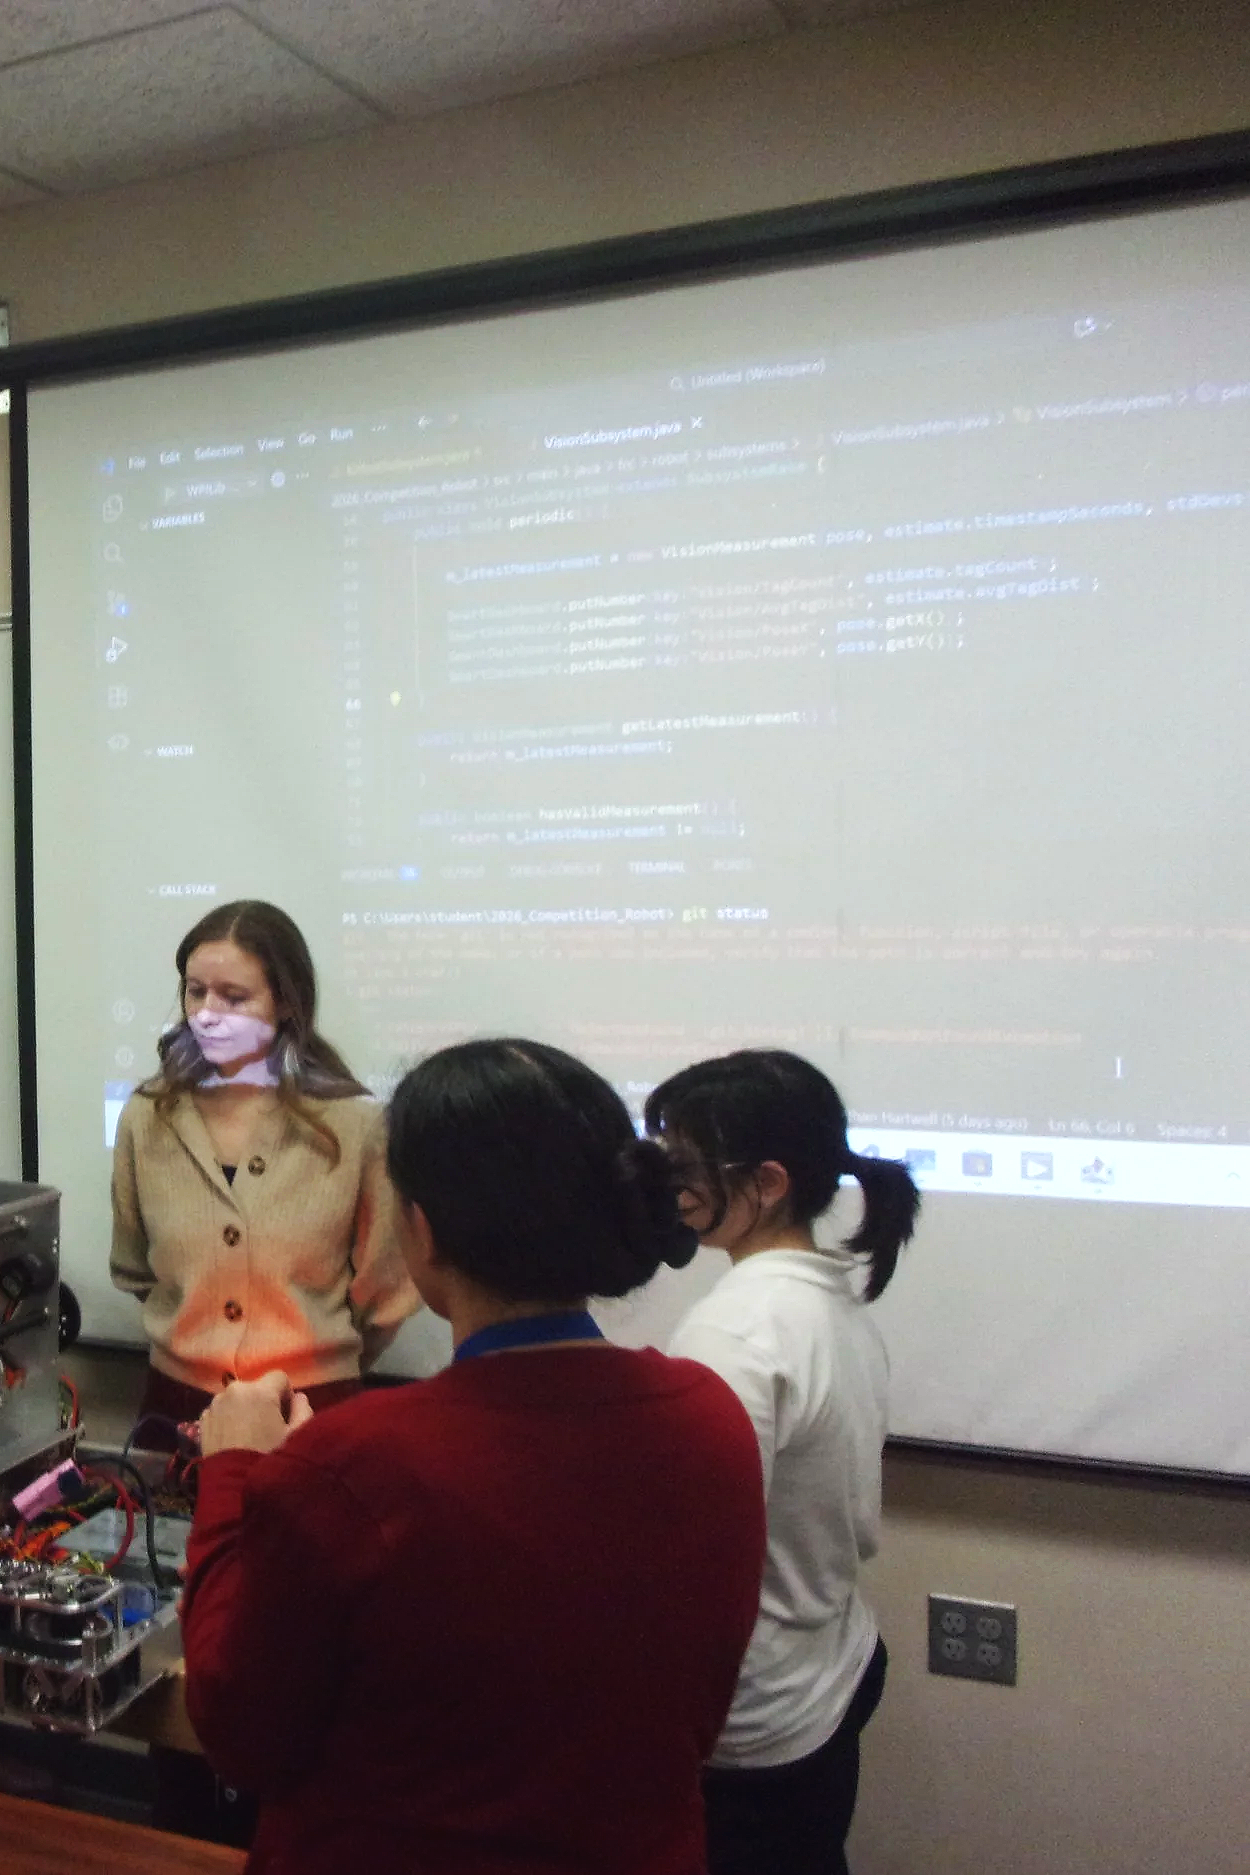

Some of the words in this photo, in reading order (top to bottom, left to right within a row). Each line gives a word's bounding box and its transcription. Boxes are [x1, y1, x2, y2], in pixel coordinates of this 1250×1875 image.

[160, 451, 181, 465] Edit
[194, 444, 245, 461] Selection
[258, 437, 285, 452] View
[298, 431, 317, 445] Go
[330, 427, 354, 442] Run
[152, 511, 206, 530] VARIABLES
[158, 883, 182, 896] CALL
[184, 882, 217, 896] STACK
[682, 906, 707, 924] git
[717, 906, 770, 921] status
[958, 1113, 992, 1130] days
[1096, 1118, 1121, 1134] Col
[1217, 1124, 1228, 1138] 4
